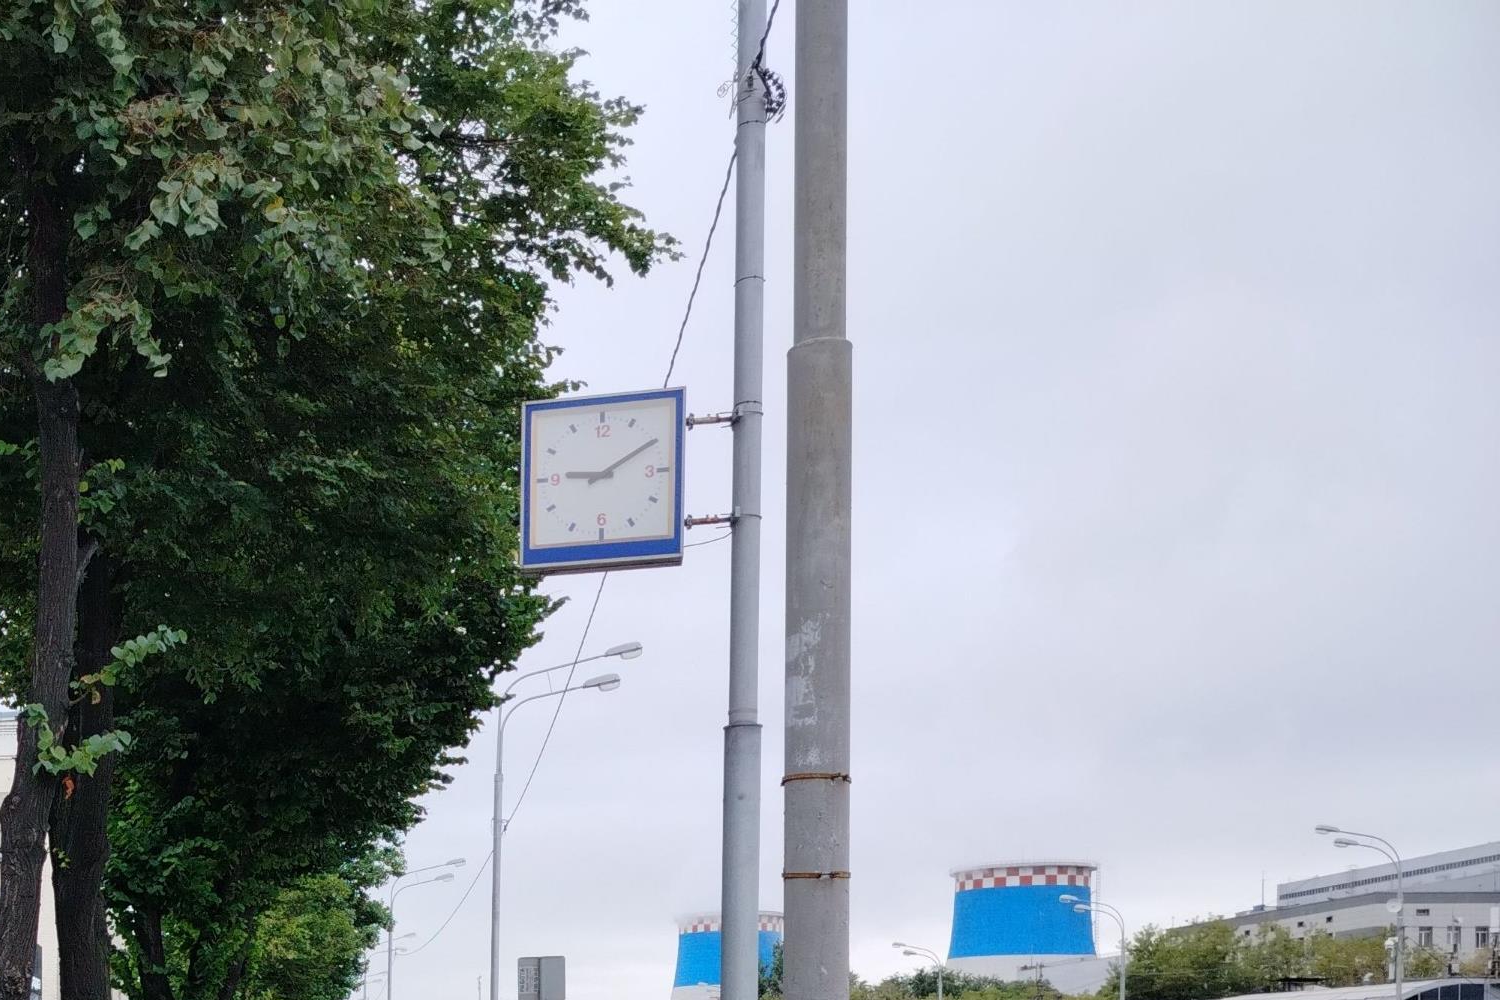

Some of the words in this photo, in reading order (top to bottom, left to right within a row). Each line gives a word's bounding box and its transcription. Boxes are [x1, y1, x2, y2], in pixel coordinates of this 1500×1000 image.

[595, 425, 611, 438] 12
[645, 465, 654, 478] 3
[551, 473, 560, 486] 9
[597, 513, 606, 526] 6
